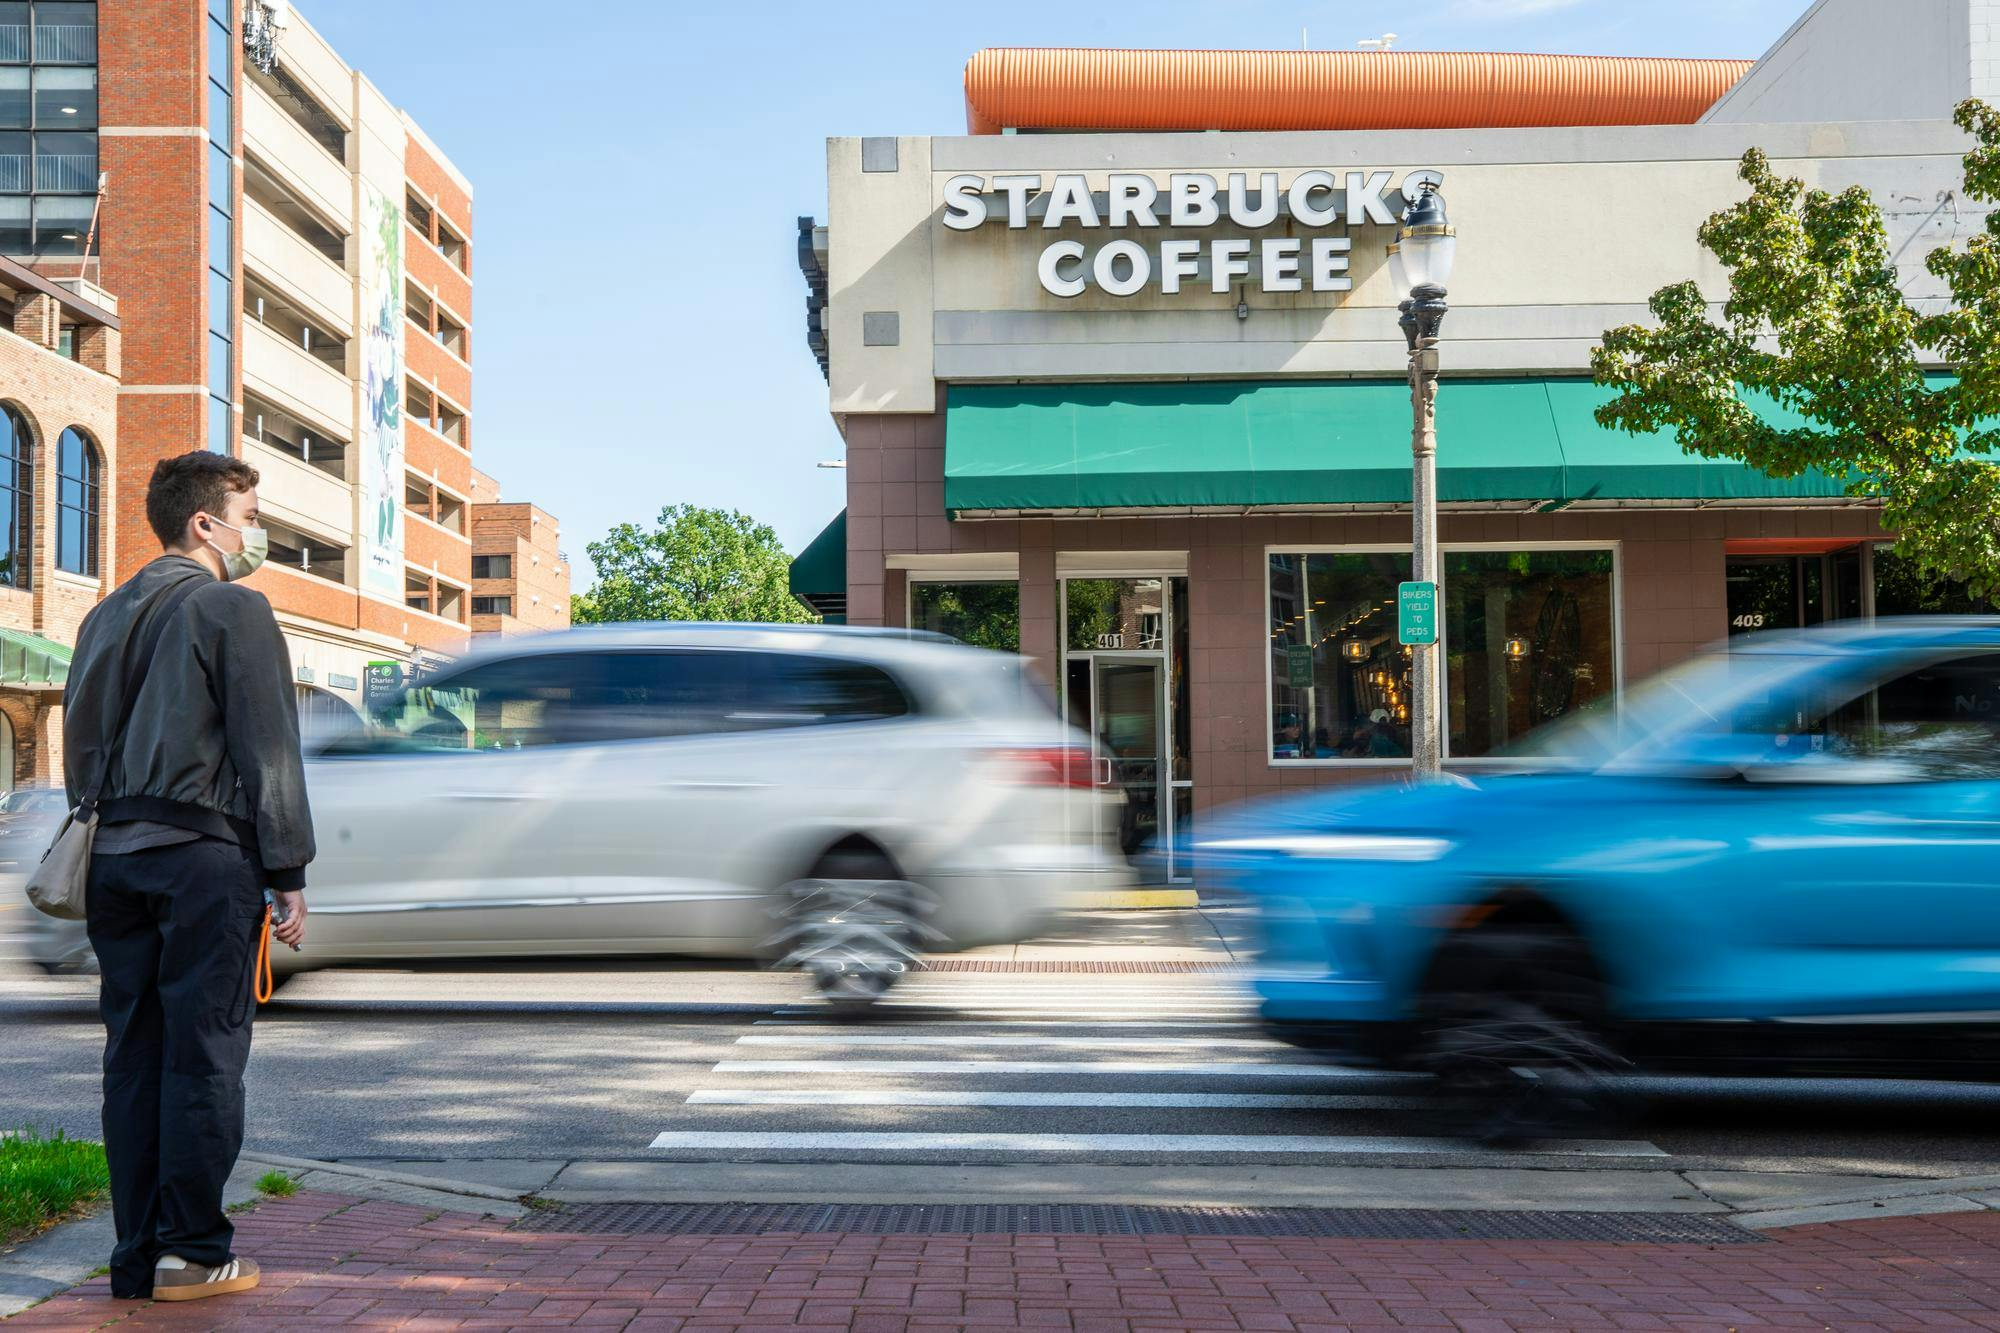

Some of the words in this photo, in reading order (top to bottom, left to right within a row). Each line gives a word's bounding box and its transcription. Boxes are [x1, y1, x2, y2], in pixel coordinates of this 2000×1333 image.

[943, 170, 1446, 231] STARBUCKS
[1037, 237, 1352, 296] COFFEE
[1402, 591, 1432, 599] BIKERS
[1733, 614, 1764, 627] 403
[1099, 634, 1122, 648] 401
